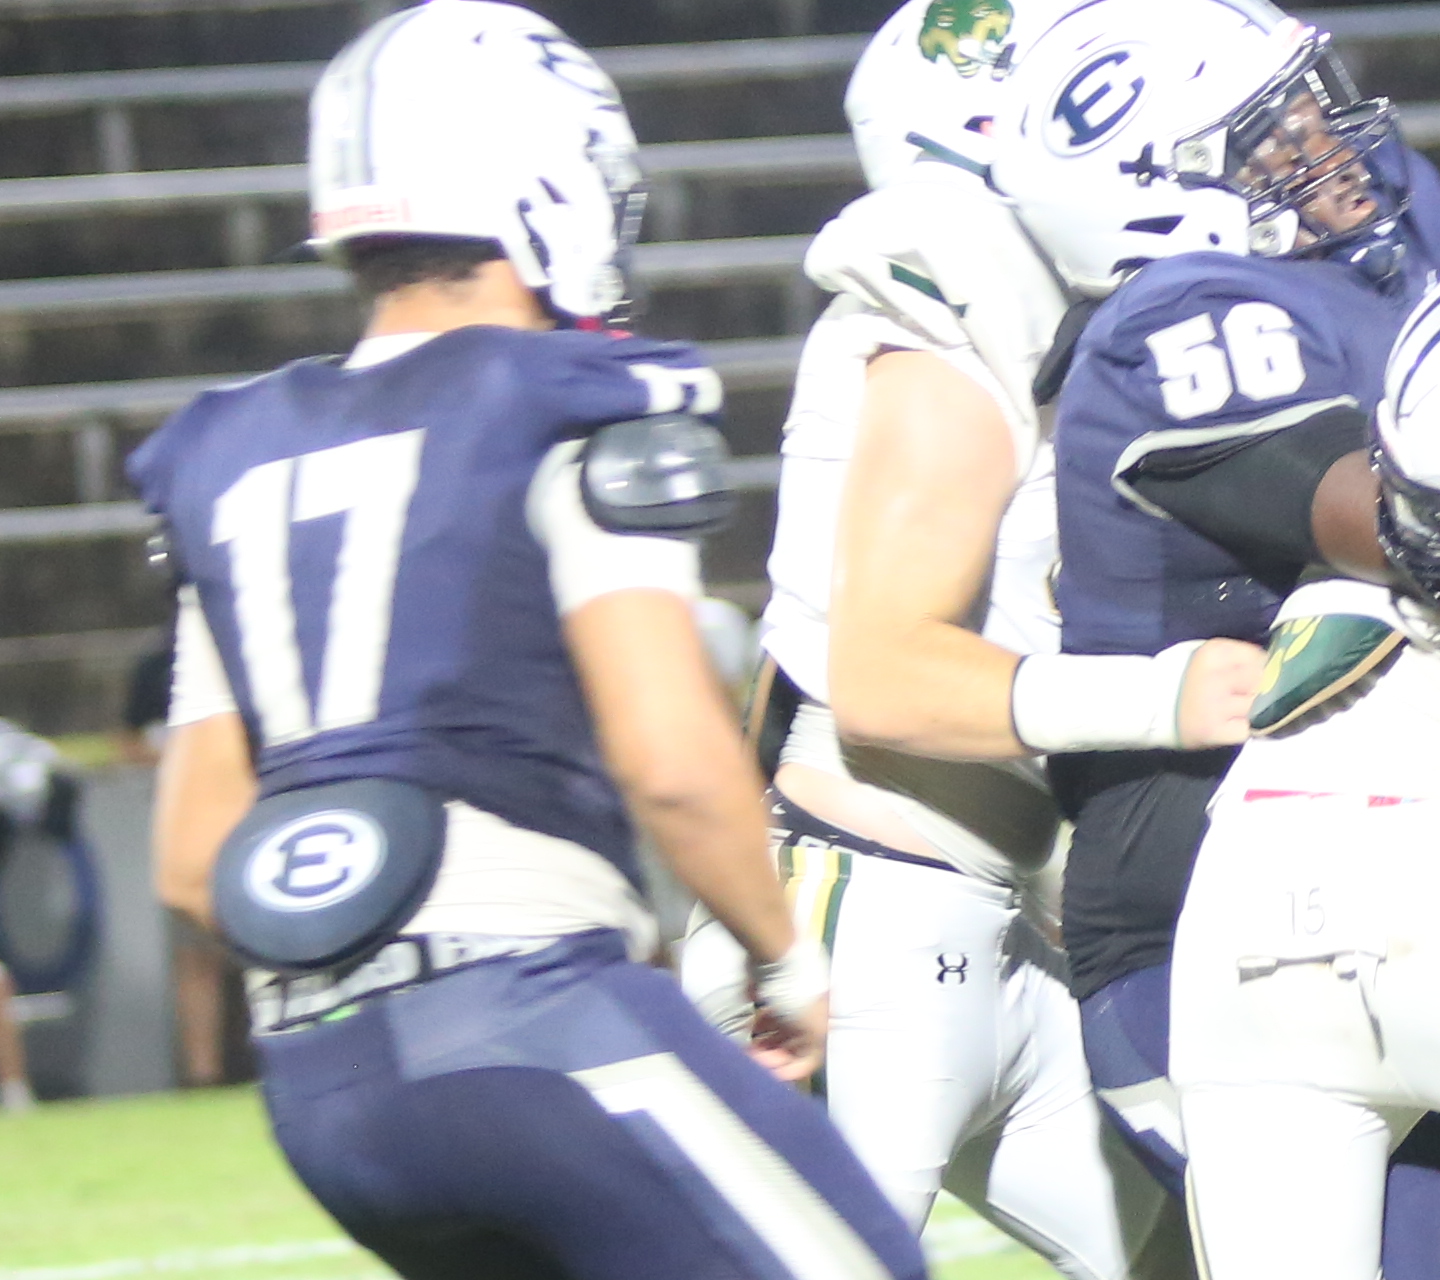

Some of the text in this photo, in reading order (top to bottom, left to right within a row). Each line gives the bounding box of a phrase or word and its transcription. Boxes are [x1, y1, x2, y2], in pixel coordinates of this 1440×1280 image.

[1052, 51, 1146, 148] E
[1145, 302, 1307, 422] 56
[211, 427, 427, 751] 17
[267, 824, 353, 897] E
[1286, 886, 1326, 936] 15
